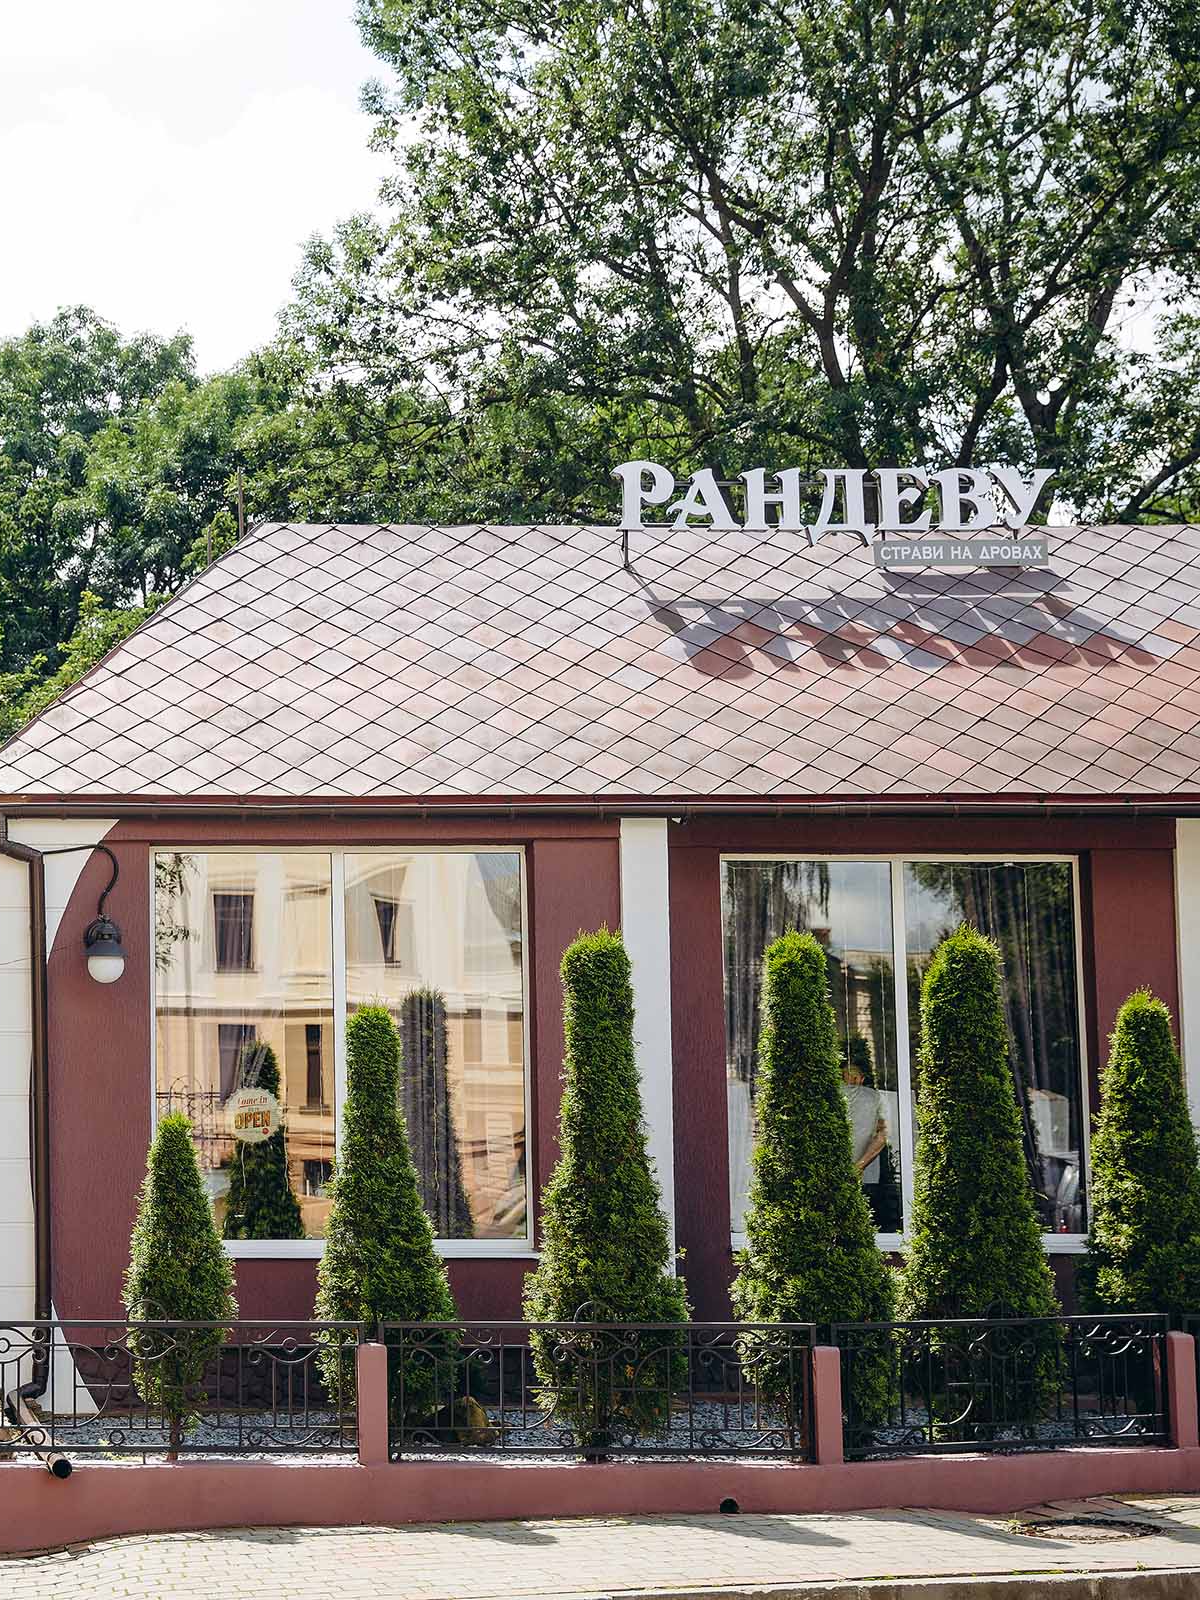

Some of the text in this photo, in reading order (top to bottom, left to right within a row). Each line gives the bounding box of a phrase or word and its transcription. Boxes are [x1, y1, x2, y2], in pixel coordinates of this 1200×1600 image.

[611, 461, 1056, 547] РАНДЕВУ
[880, 545, 1042, 560] СТРАВИ НА ДРОВАХ
[234, 1110, 270, 1129] OPEN
